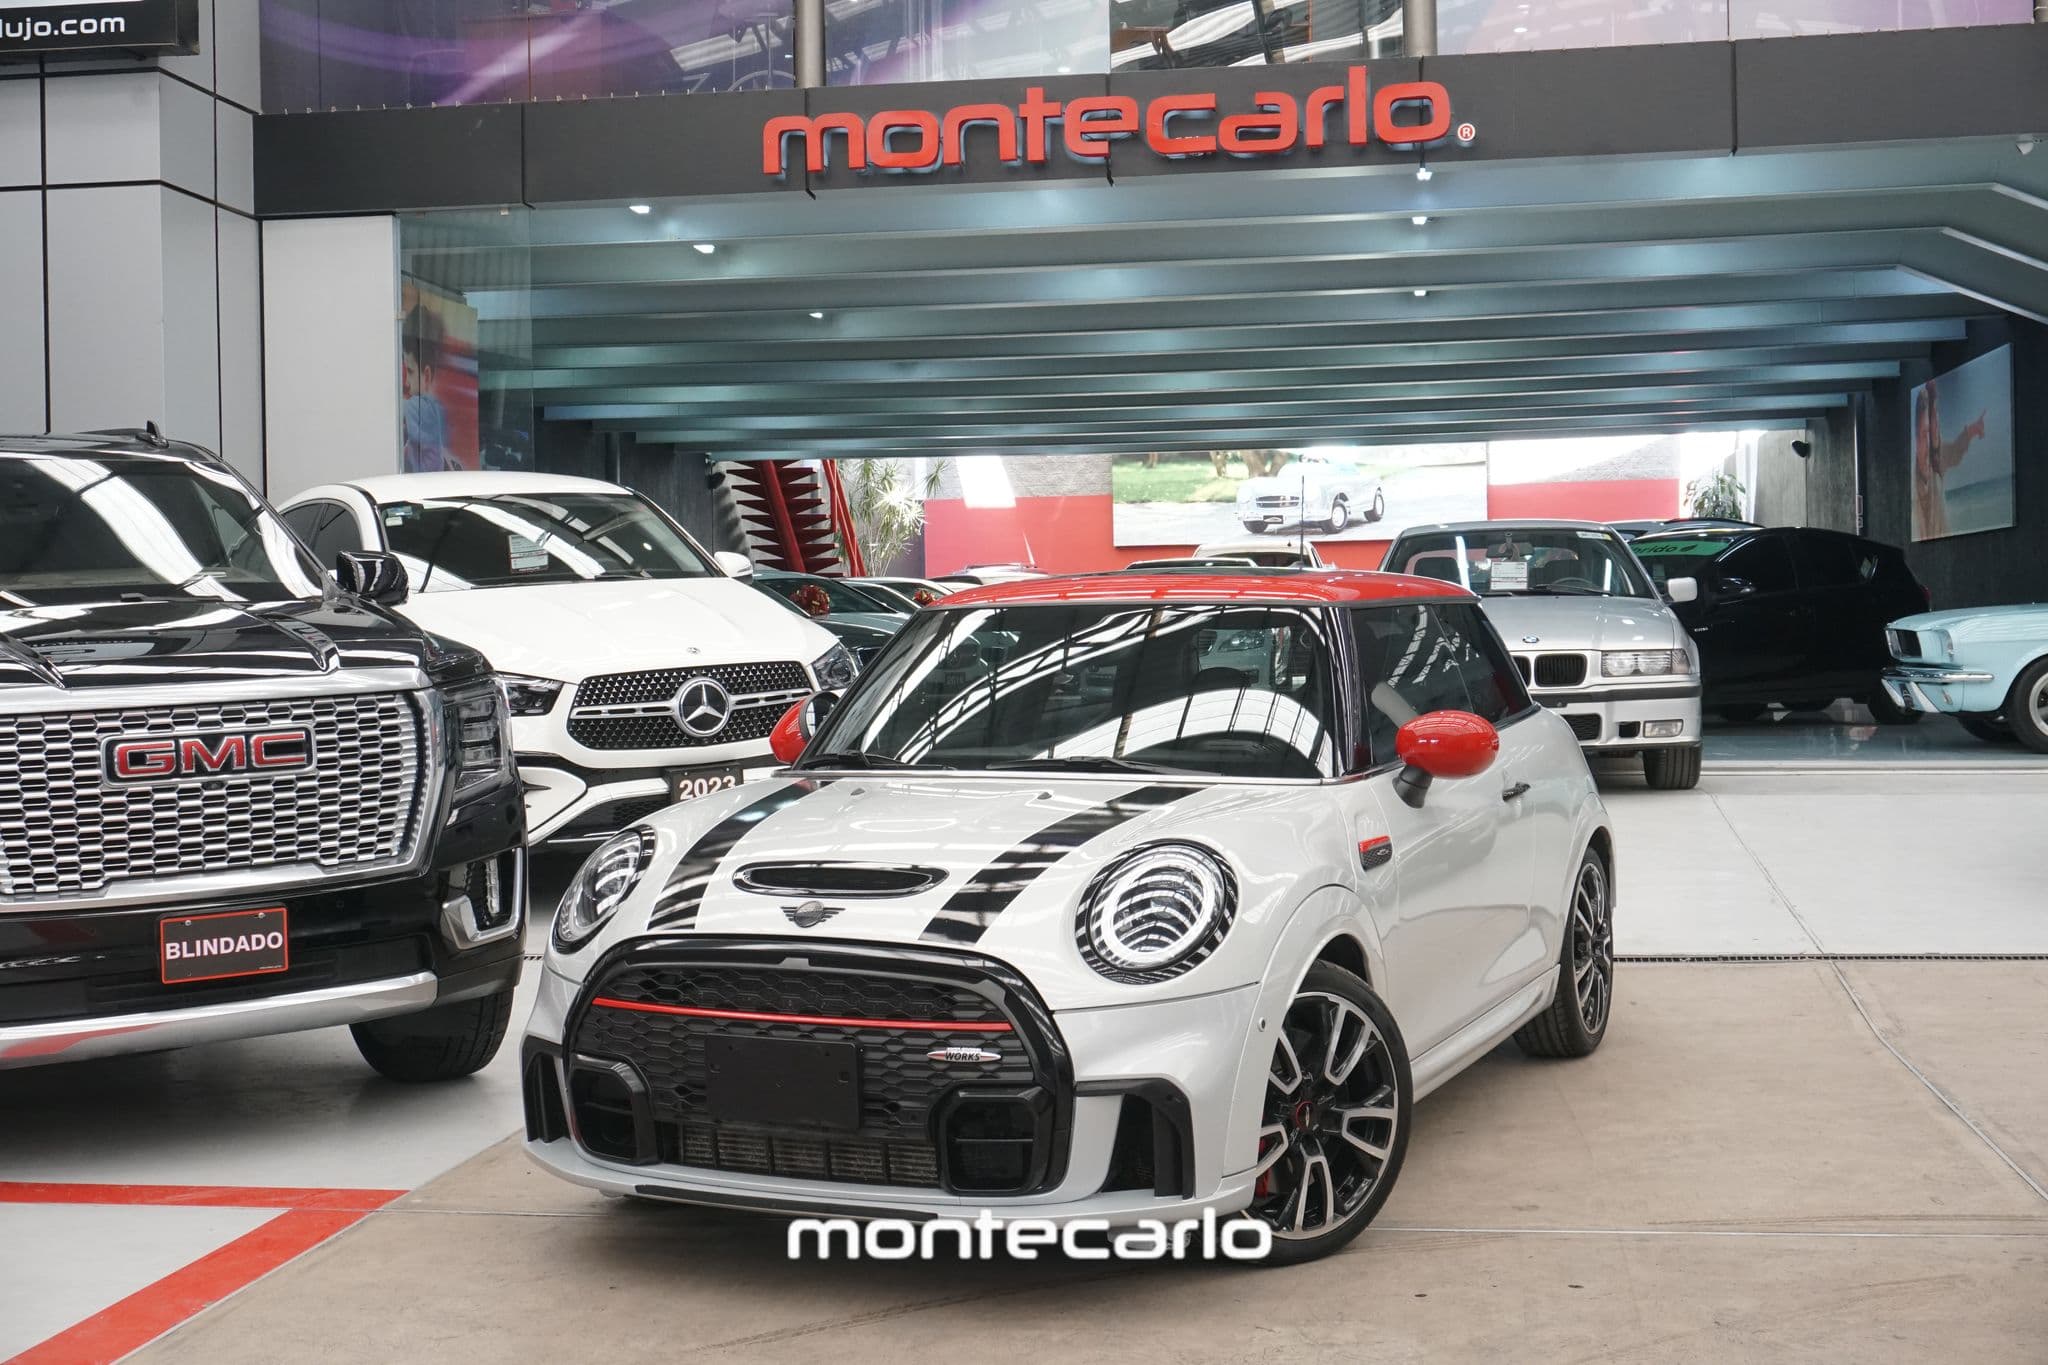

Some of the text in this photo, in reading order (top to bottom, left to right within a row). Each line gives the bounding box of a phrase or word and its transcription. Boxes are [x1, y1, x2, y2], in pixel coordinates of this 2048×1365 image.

[762, 65, 1452, 176] montecarlo
[114, 731, 307, 779] GMC
[679, 775, 736, 801] 2023
[165, 931, 284, 961] BLINDADO
[944, 1051, 982, 1062] WORKS
